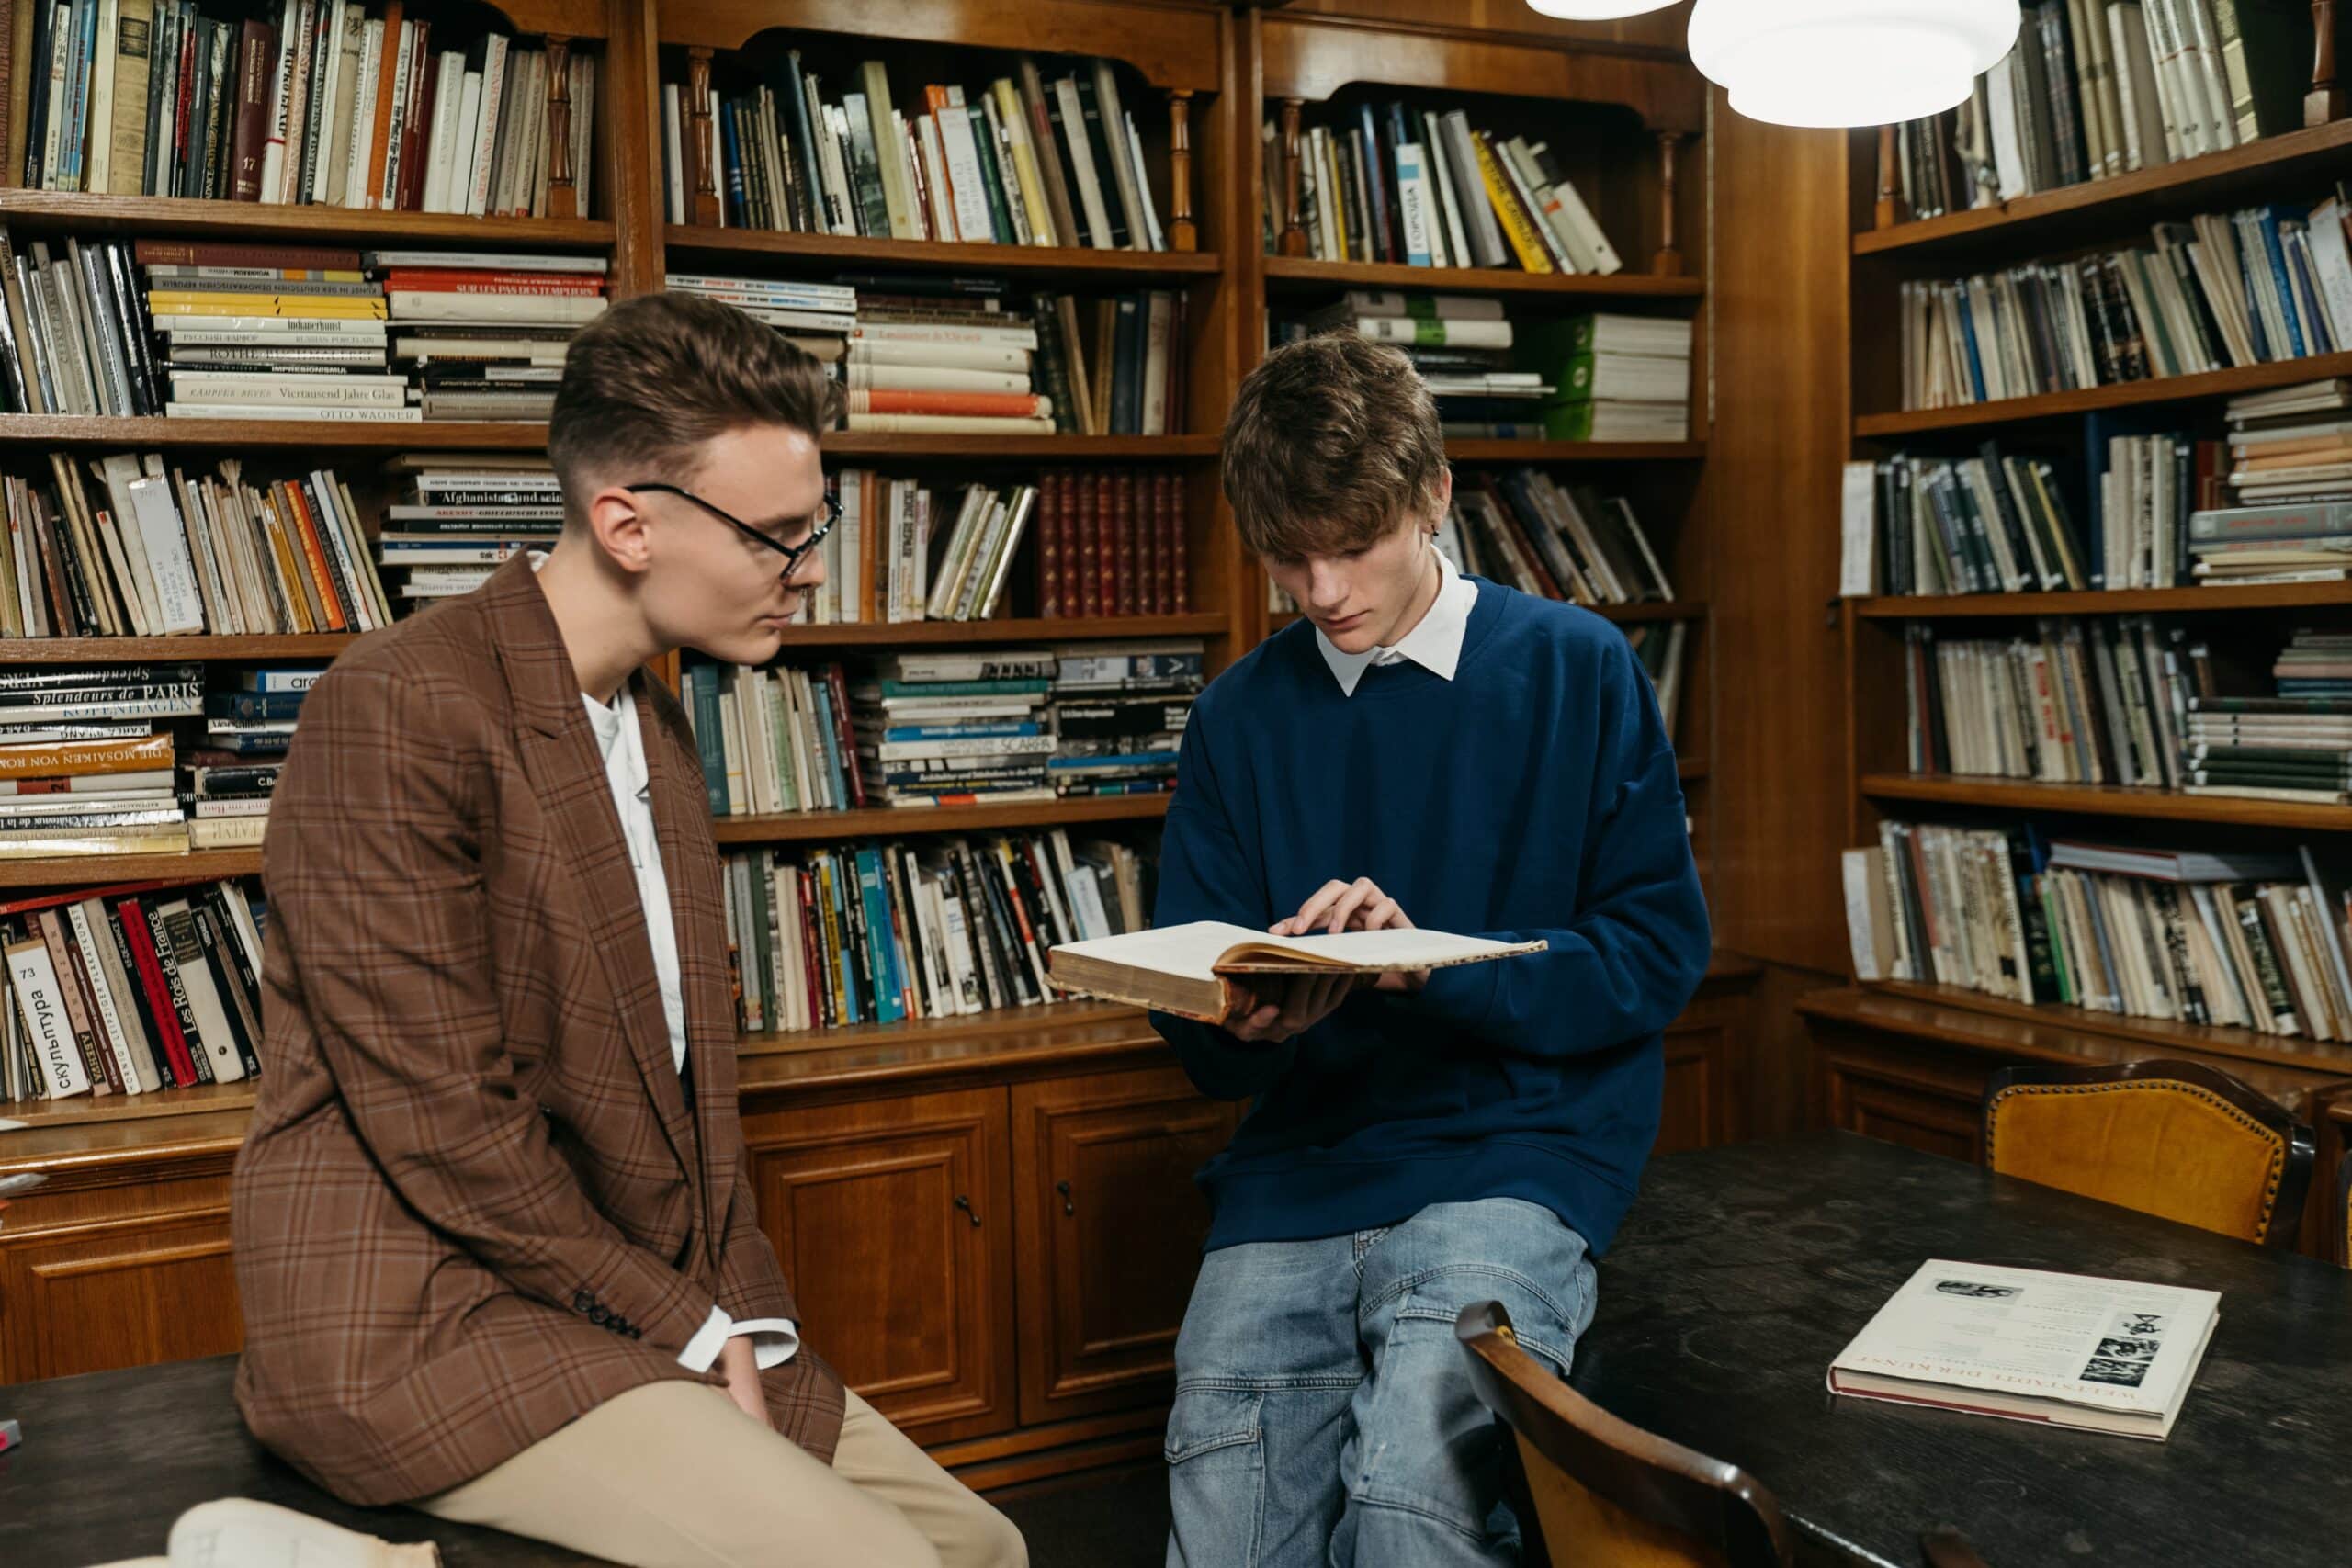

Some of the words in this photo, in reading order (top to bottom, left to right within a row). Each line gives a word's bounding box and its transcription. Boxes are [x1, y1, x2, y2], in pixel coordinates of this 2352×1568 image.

[243, 157, 255, 171] 17
[161, 279, 196, 288] REPUBLIK
[198, 281, 271, 291] DEMOKRATISCHEN
[273, 283, 319, 292] DEUTSCHEN
[456, 283, 476, 292] SUR
[479, 284, 496, 293] LES
[499, 285, 517, 294] PAS
[519, 285, 538, 294] DES
[540, 286, 593, 296] TEMPLIERS
[350, 286, 376, 294] KUNST
[278, 388, 341, 400] Viertausend
[344, 388, 369, 401] Jahre
[372, 389, 396, 400] Glas
[320, 411, 354, 420] OTTO
[359, 410, 414, 421] WAGNER
[517, 492, 537, 502] und
[33, 689, 114, 705] Splendeurs
[118, 687, 135, 700] de
[143, 682, 200, 699] PARIS
[62, 698, 193, 718] KOPENHAGEN
[1001, 739, 1051, 751] SCARPA
[63, 750, 136, 764] MOSAIKEN
[141, 748, 161, 758] DIE
[30, 756, 59, 766] VON
[203, 804, 226, 815] Bau
[6, 818, 17, 828] la
[19, 818, 31, 827] de
[34, 816, 79, 828] Châteaux
[147, 912, 170, 957] France
[71, 908, 101, 981] PLAKATKUNST
[161, 956, 177, 976] de
[19, 967, 36, 979] 73
[170, 976, 187, 1009] Rois
[96, 985, 119, 1040] LEIPZIGER
[181, 1007, 197, 1034] Les
[31, 988, 72, 1088] скульптура
[1855, 1354, 1931, 1371] KUNST
[1939, 1366, 1982, 1377] DER
